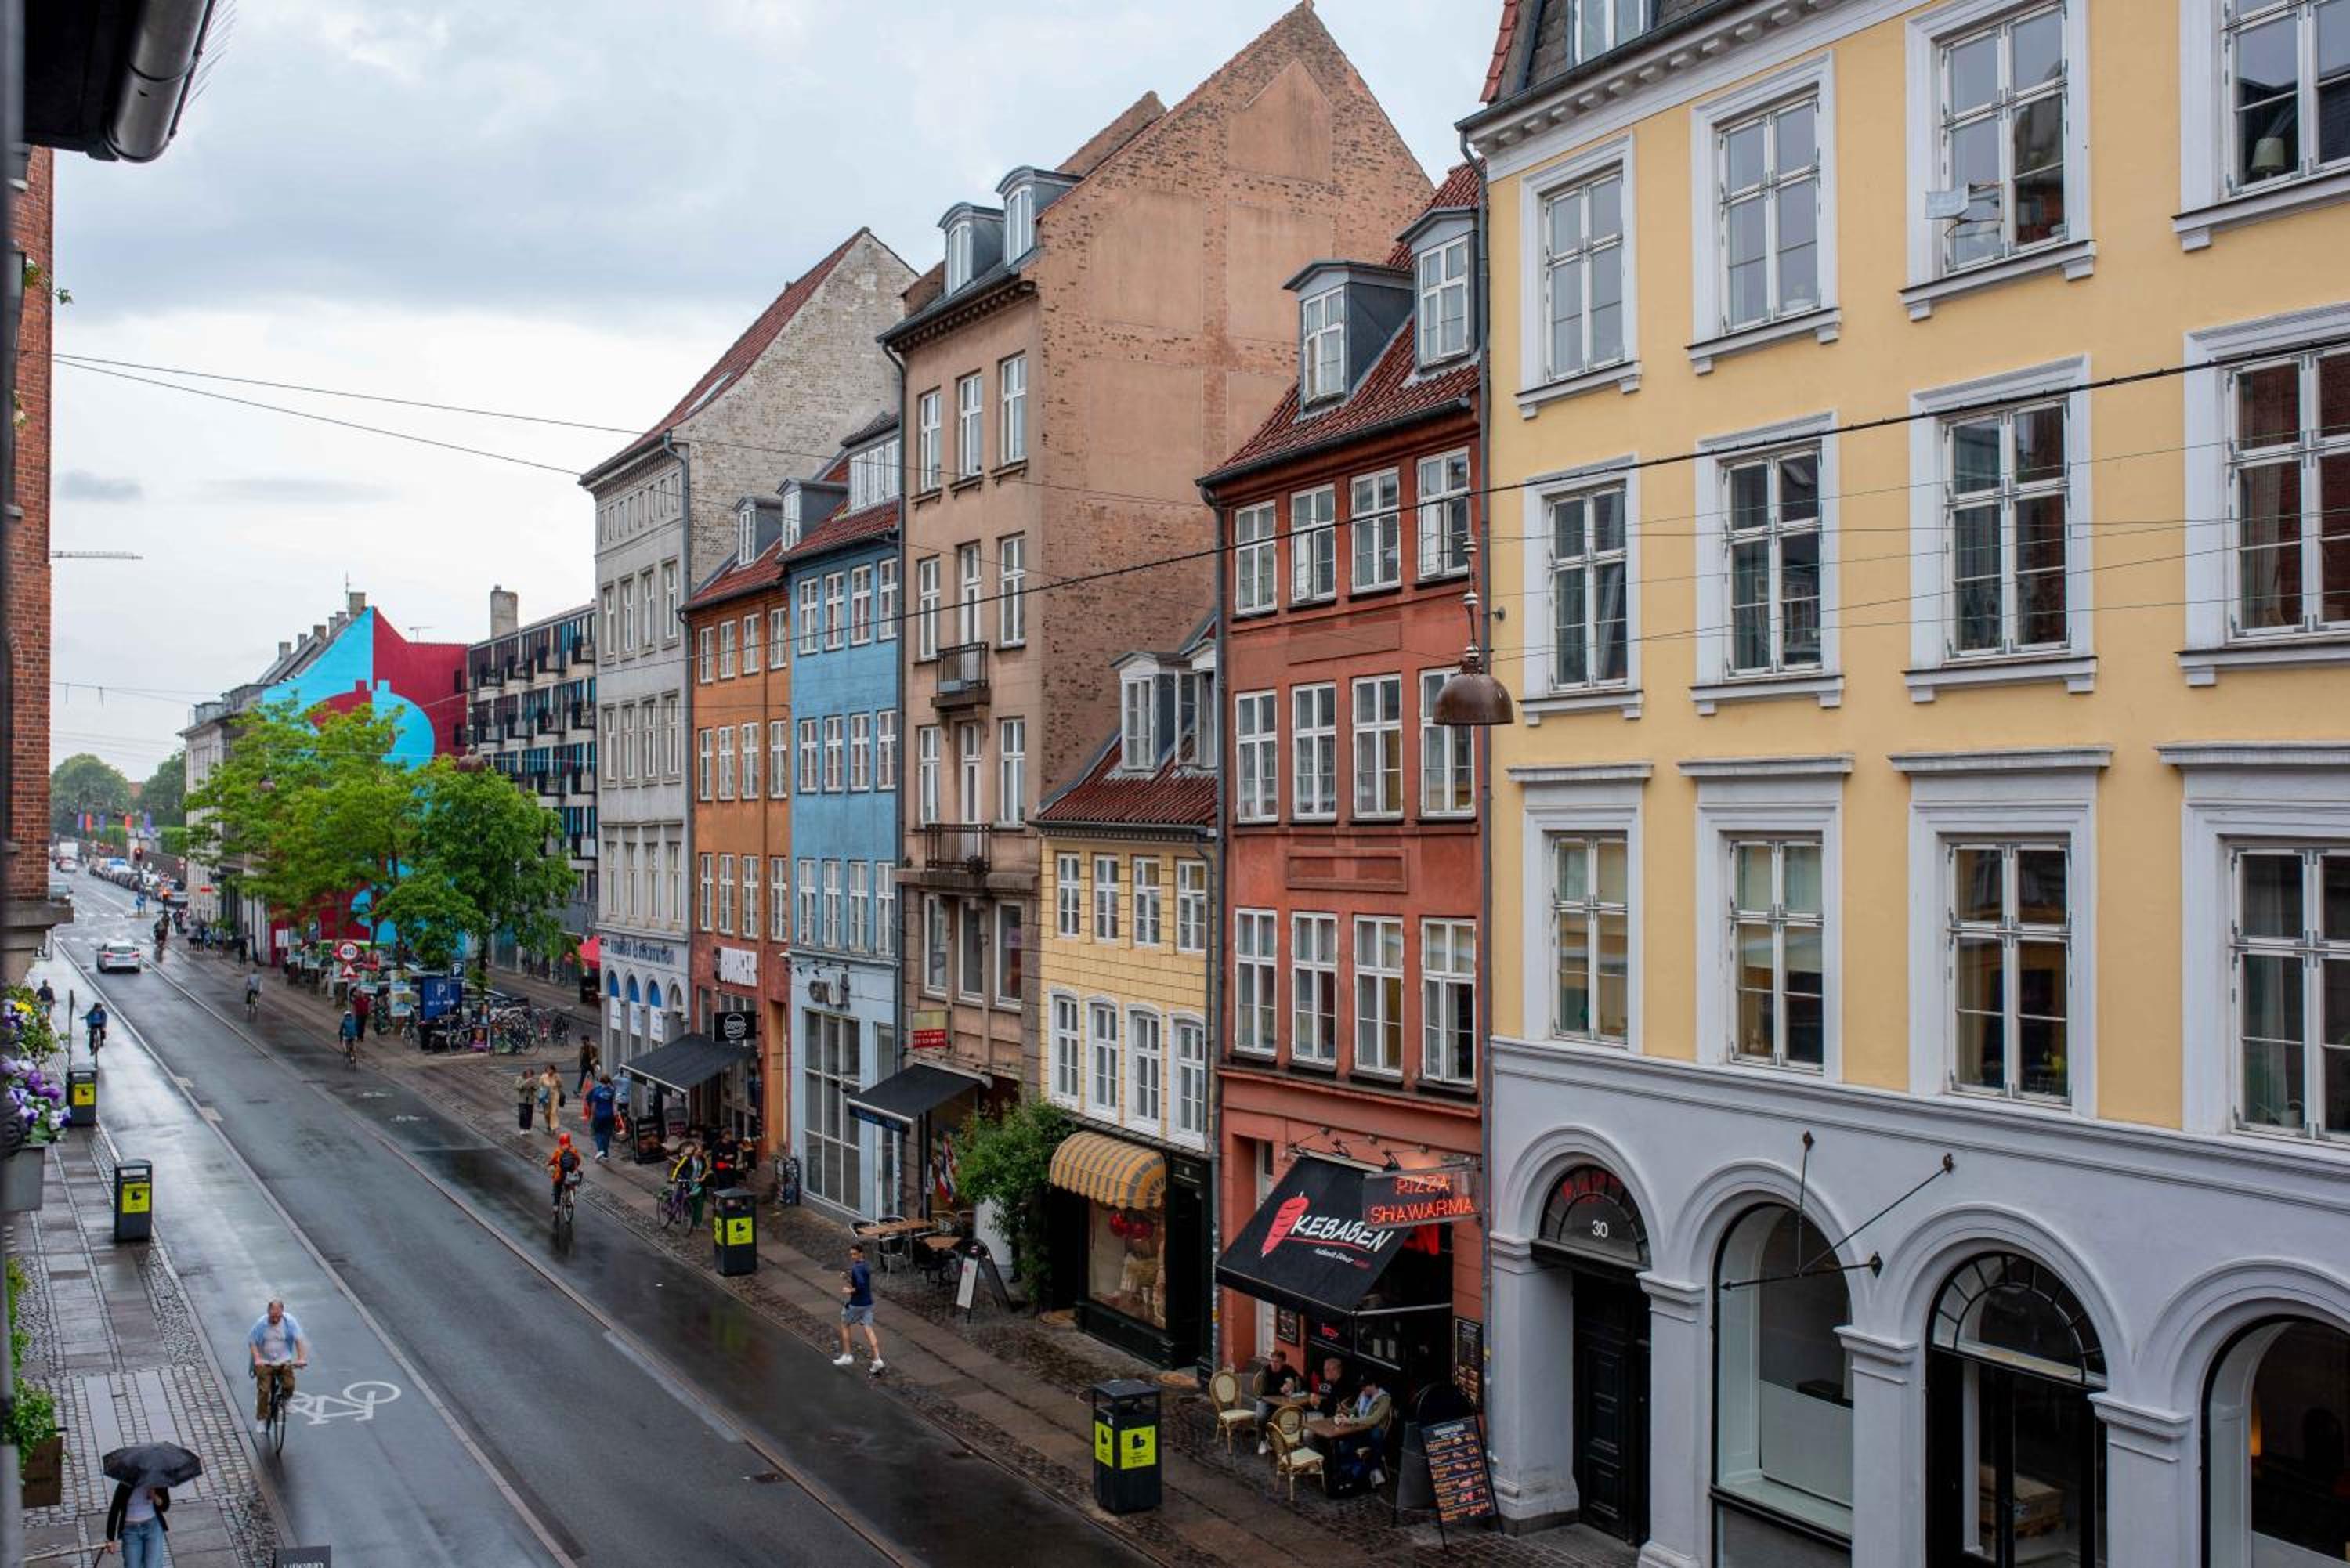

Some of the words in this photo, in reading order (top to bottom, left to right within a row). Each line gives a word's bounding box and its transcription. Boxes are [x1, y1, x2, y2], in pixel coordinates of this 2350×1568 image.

[342, 946, 354, 956] 40
[437, 983, 446, 997] P
[1396, 1176, 1450, 1195] PIZZA
[1370, 1196, 1475, 1224] SHAWARMA
[1290, 1215, 1394, 1252] KEBABEN
[1592, 1219, 1608, 1238] 30
